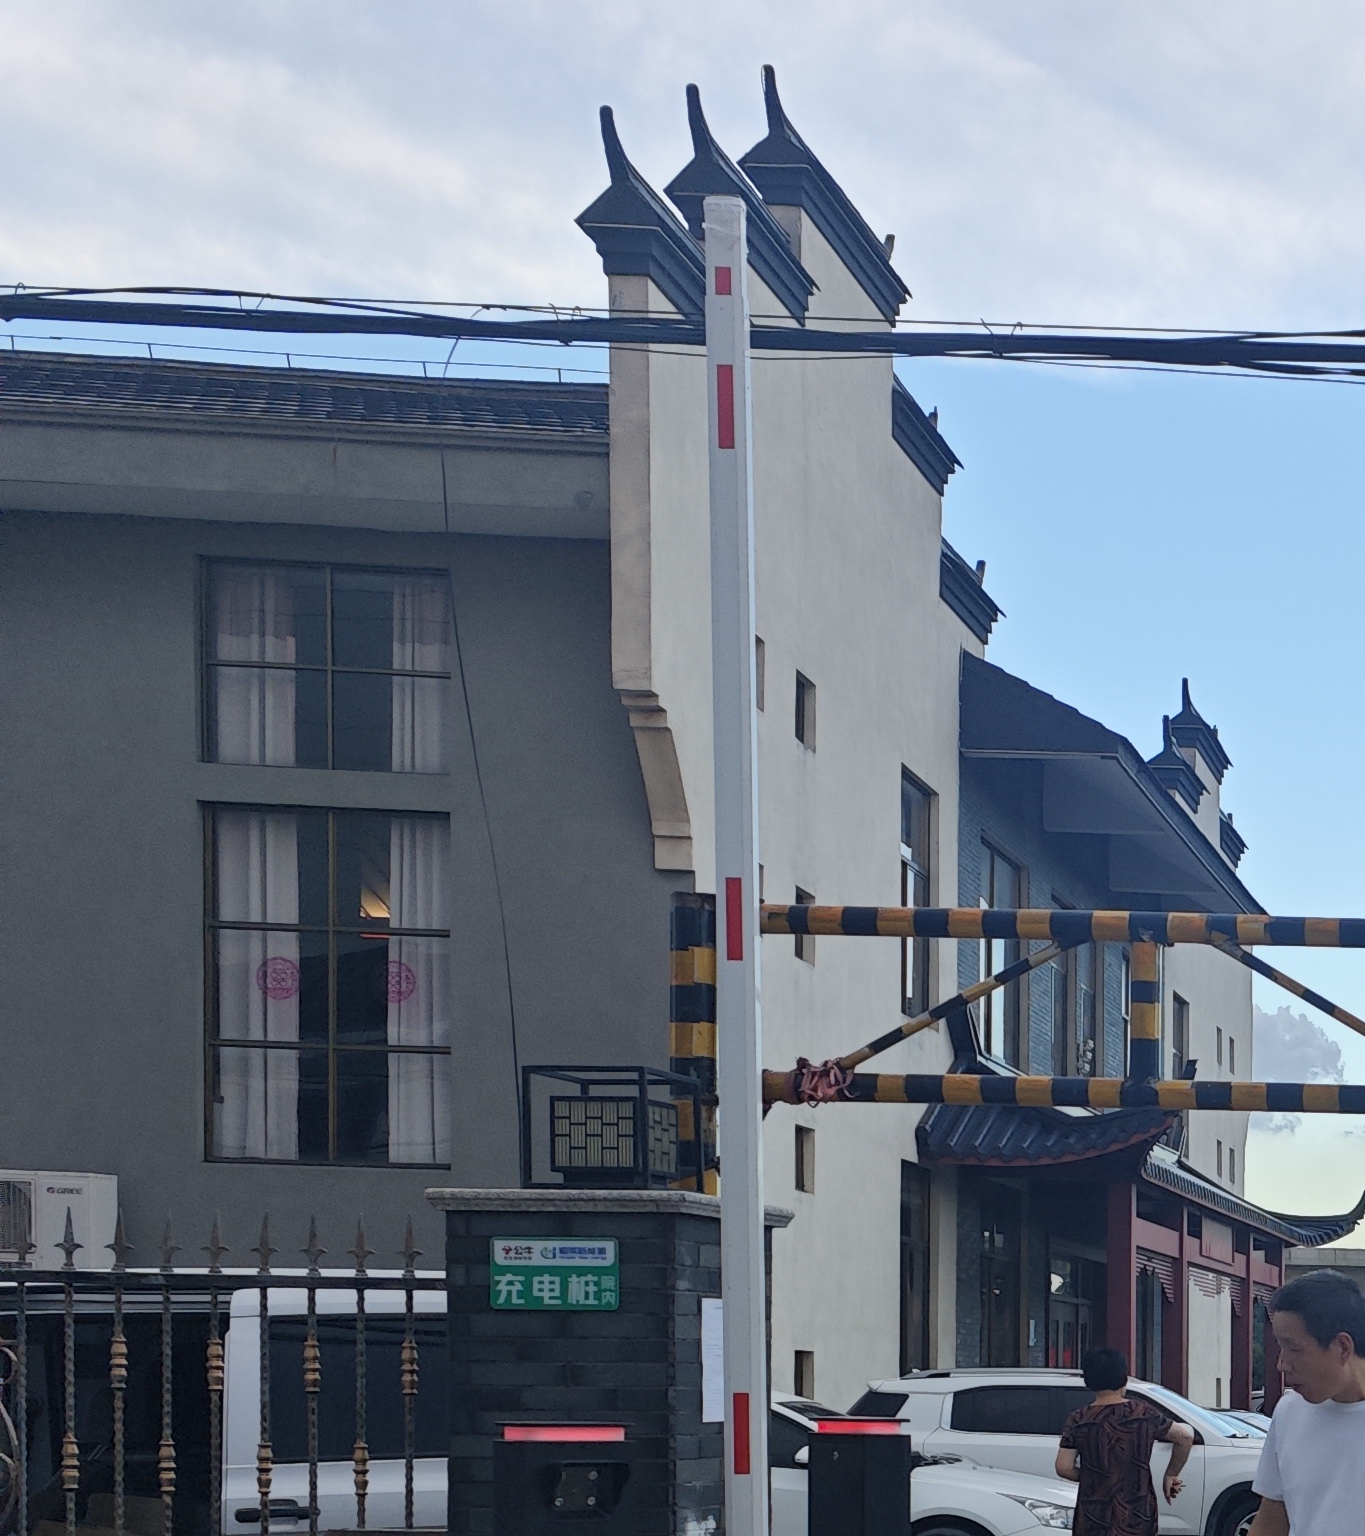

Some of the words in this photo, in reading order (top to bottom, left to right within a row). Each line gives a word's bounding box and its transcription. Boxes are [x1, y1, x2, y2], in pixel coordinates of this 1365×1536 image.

[513, 1245, 535, 1255] 公牛
[493, 1273, 599, 1305] 充电桩
[600, 1275, 616, 1306] 院内
